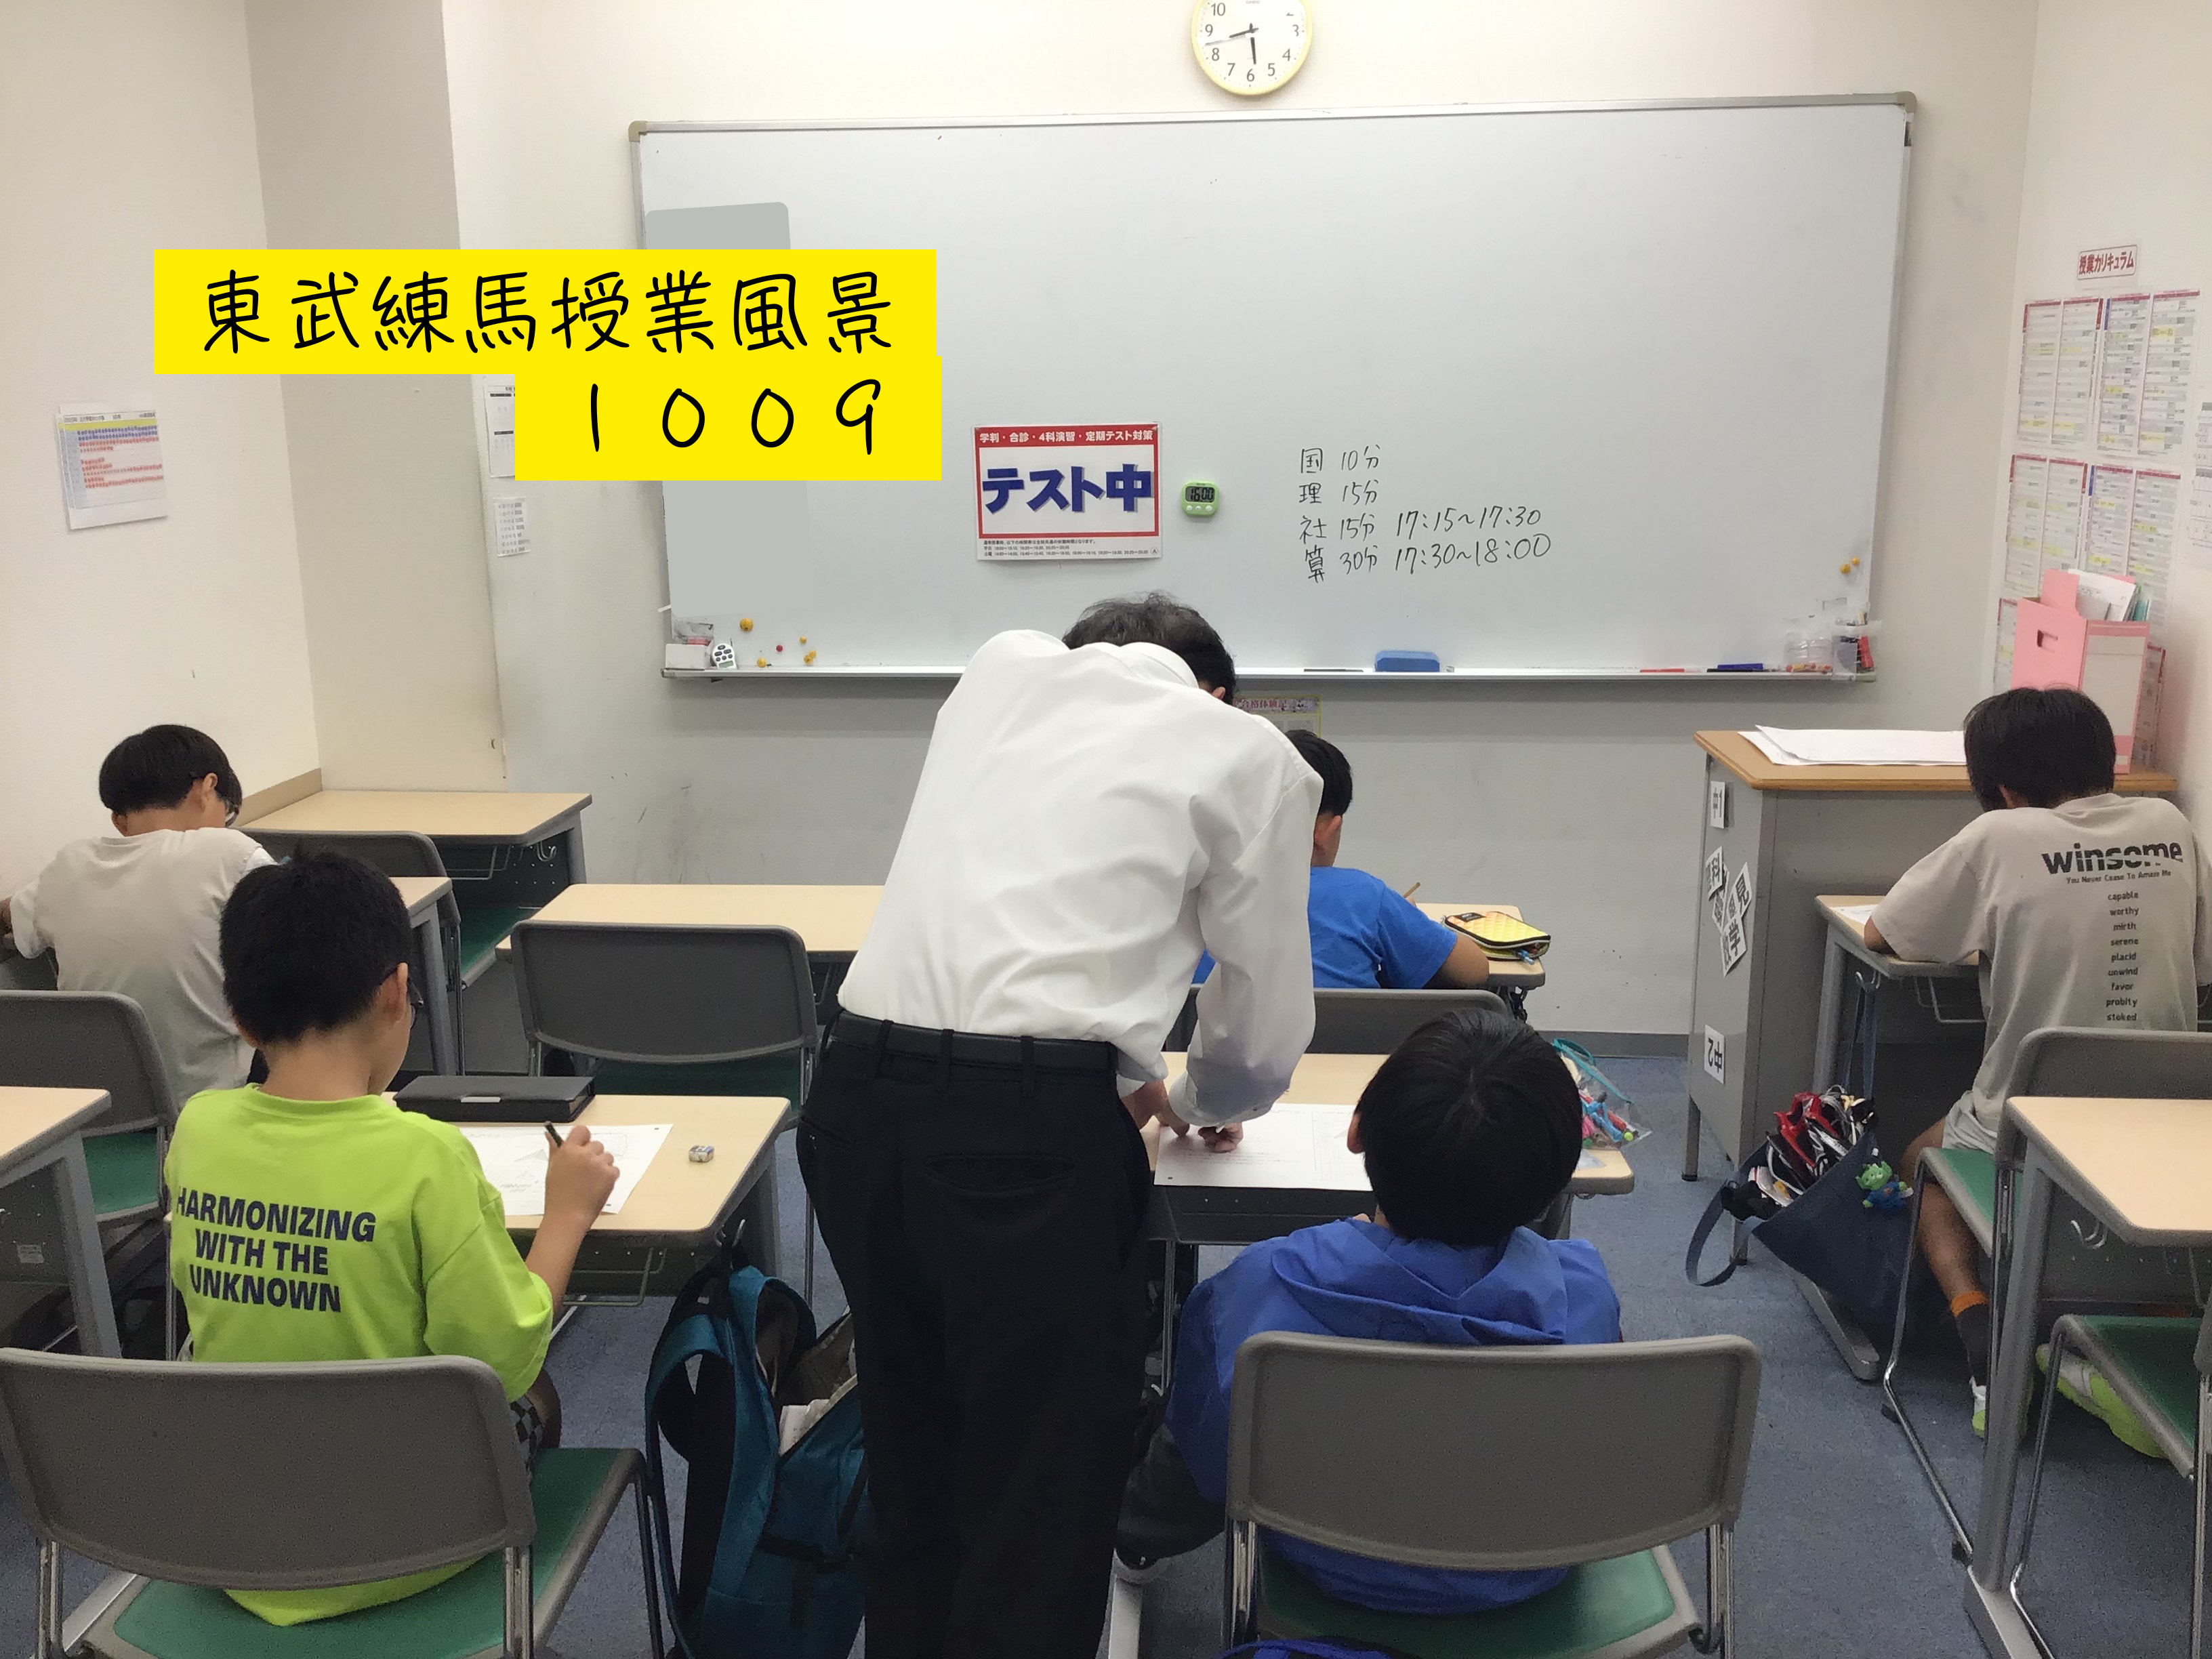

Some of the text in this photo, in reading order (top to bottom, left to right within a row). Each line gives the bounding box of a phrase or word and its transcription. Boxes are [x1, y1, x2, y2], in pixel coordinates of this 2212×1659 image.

[1211, 2, 1226, 16] 10
[1205, 24, 1214, 37] 9
[1292, 24, 1299, 37] 3
[1211, 47, 1220, 61] 8
[1282, 48, 1291, 62] 4
[1227, 62, 1235, 76] 7
[1246, 68, 1255, 82] 6
[1267, 62, 1275, 77] 5
[2078, 251, 2134, 275] 授業カリキュラム
[1300, 444, 1380, 474] 国 10分
[982, 463, 1154, 514] テスト中
[1298, 479, 1379, 506] 理 15分
[1299, 515, 1328, 544] 社
[1340, 512, 1375, 541] 15分
[1305, 544, 1325, 583] 算
[1339, 545, 1378, 575] 30分
[2041, 842, 2184, 874] winsome
[2081, 876, 2102, 884] Never
[2107, 890, 2139, 903] capable
[2109, 906, 2139, 916] worthy
[2113, 922, 2136, 931] mirth
[2111, 951, 2137, 963] placid
[2108, 967, 2138, 976] unwind
[2111, 981, 2133, 991] favor
[2106, 998, 2137, 1008] probity
[2106, 1012, 2137, 1021] stoked
[176, 1186, 377, 1242] HARMONIZING
[194, 1227, 329, 1275] WITH THE
[189, 1264, 342, 1313] UNKNOWN
